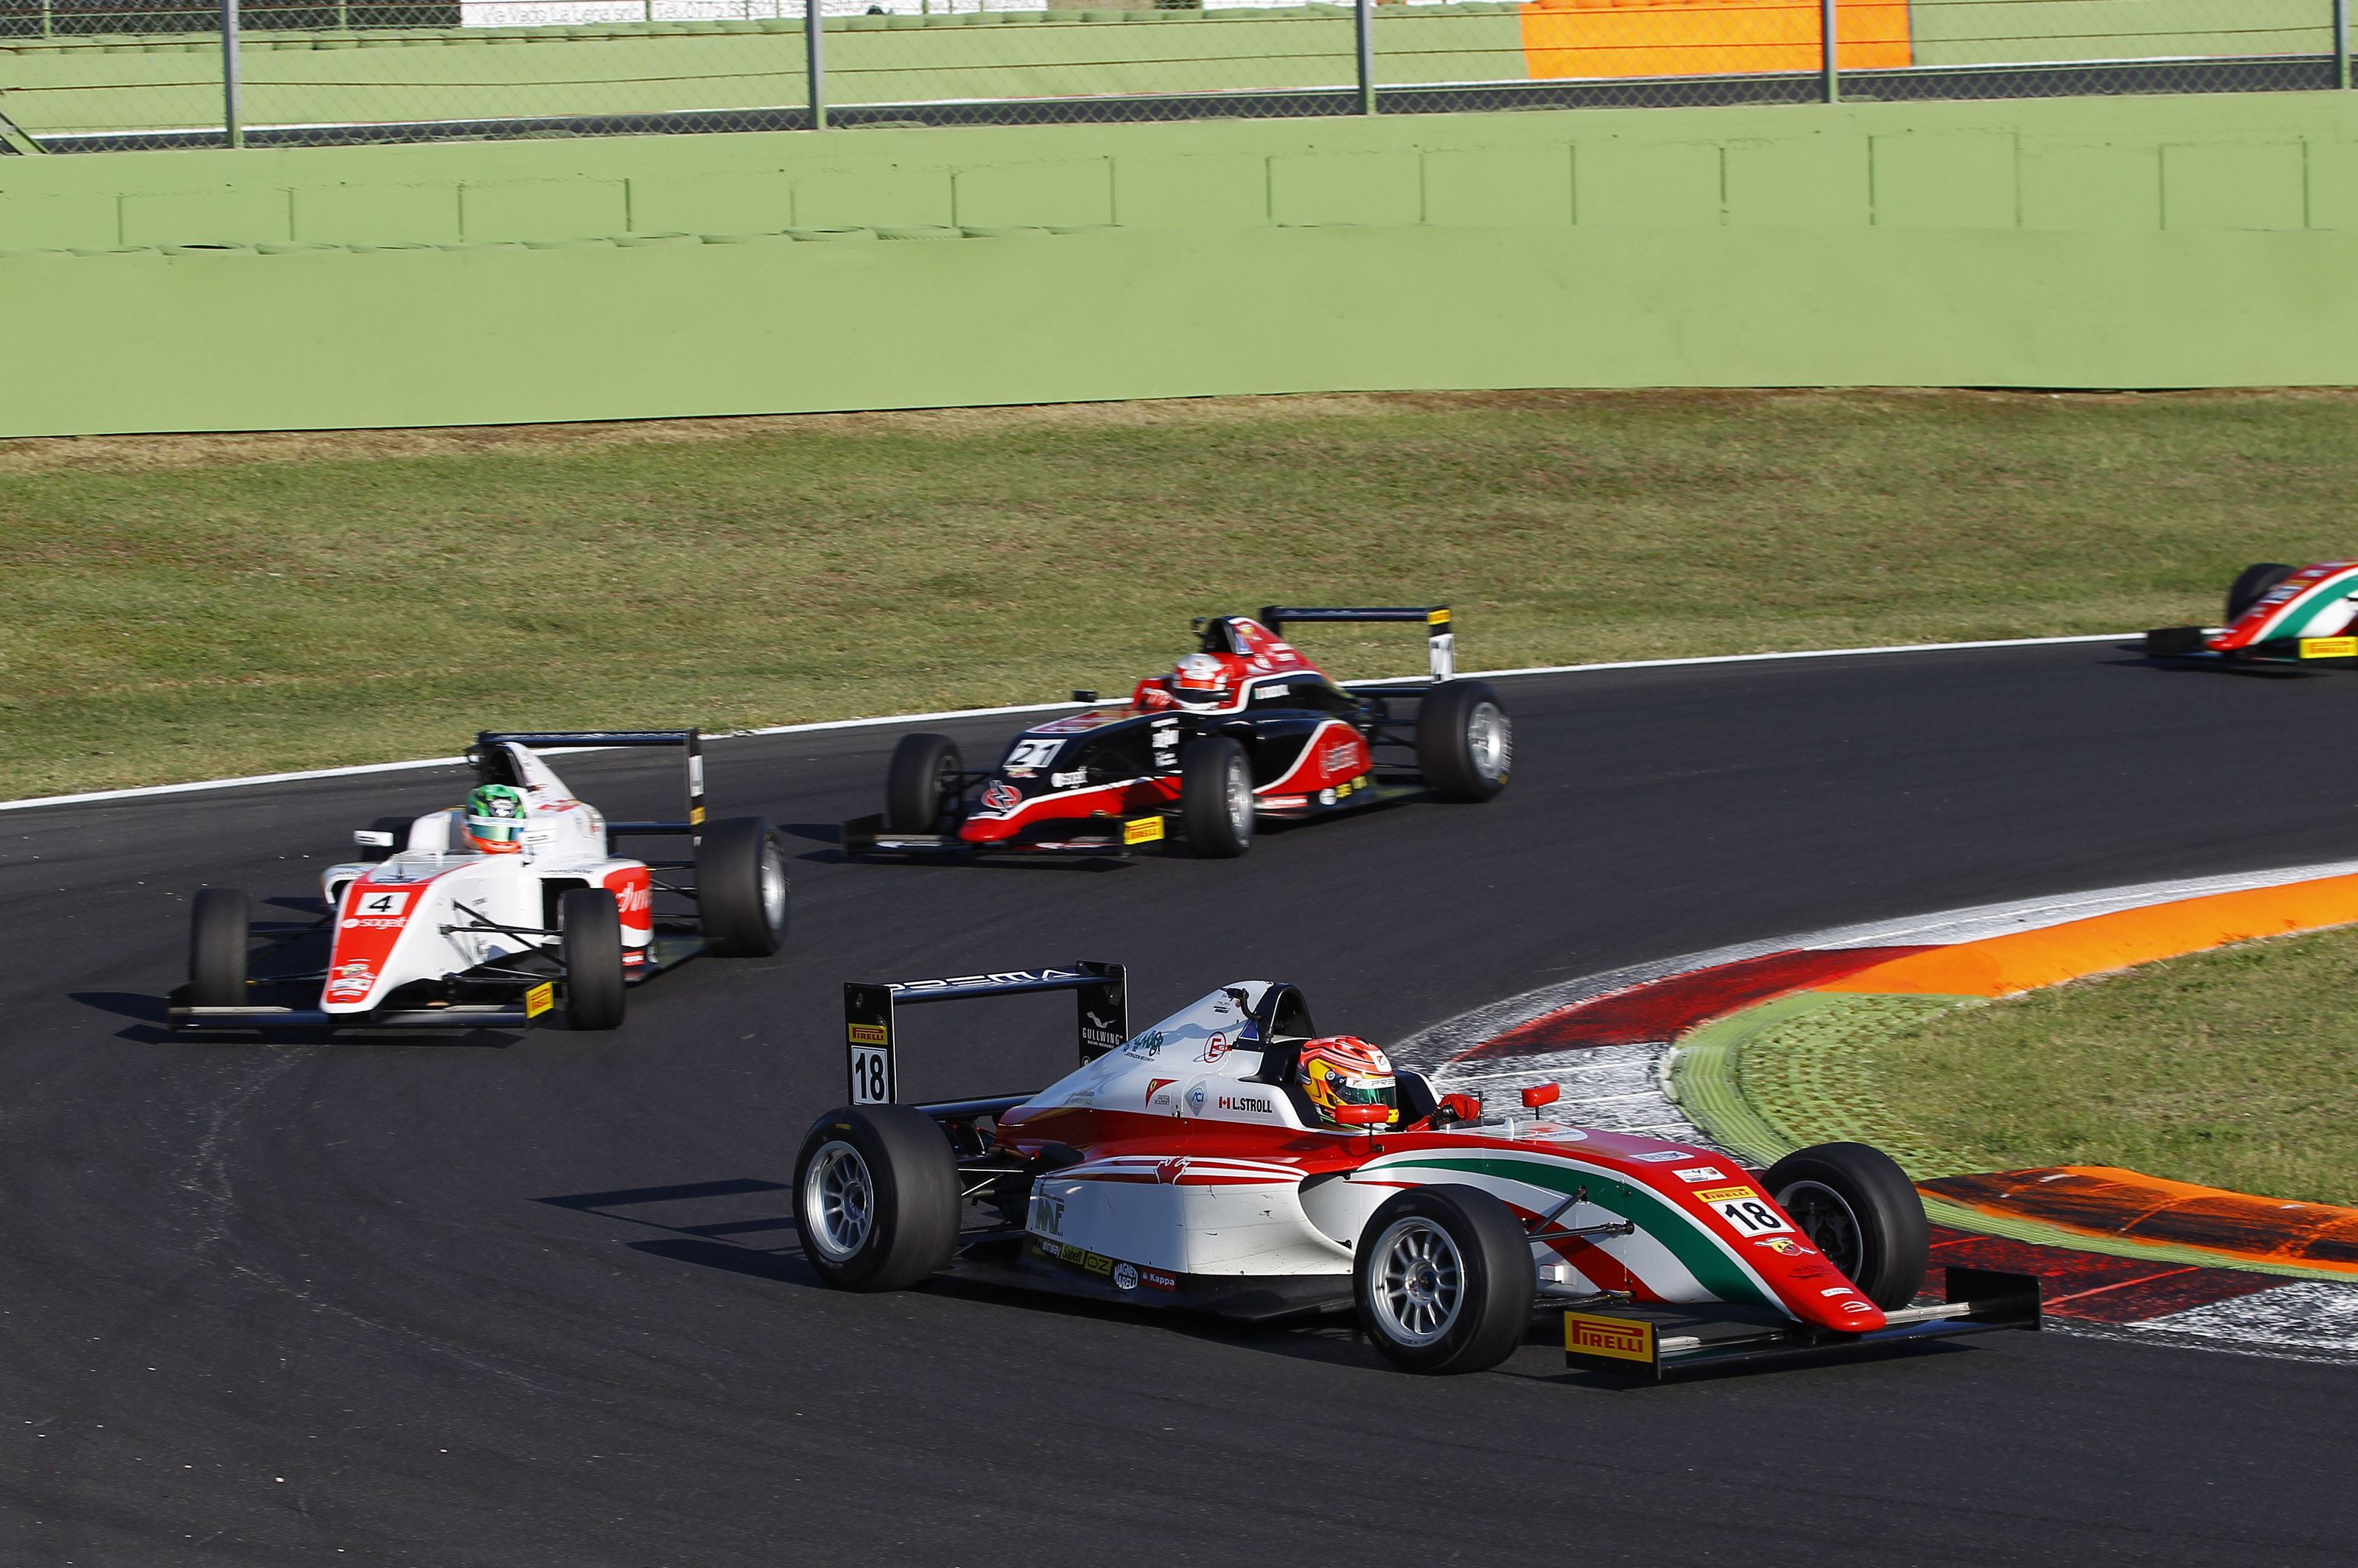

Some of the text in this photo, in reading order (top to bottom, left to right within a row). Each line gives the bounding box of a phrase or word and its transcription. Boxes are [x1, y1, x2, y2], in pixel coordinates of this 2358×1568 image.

[1007, 743, 1061, 766] 21
[368, 895, 393, 912] 4
[852, 1026, 884, 1041] PIRELLI
[1082, 1027, 1120, 1045] GULLWING
[855, 1053, 885, 1101] 18
[1233, 1097, 1273, 1113] L.STROLL
[1701, 1189, 1752, 1200] PIRELLI
[1725, 1202, 1782, 1231] 18
[1062, 1245, 1082, 1263] Sabelt
[1087, 1256, 1110, 1273] OZ
[1150, 1273, 1175, 1287] Kappa
[1572, 1319, 1645, 1354] PIRELLI
